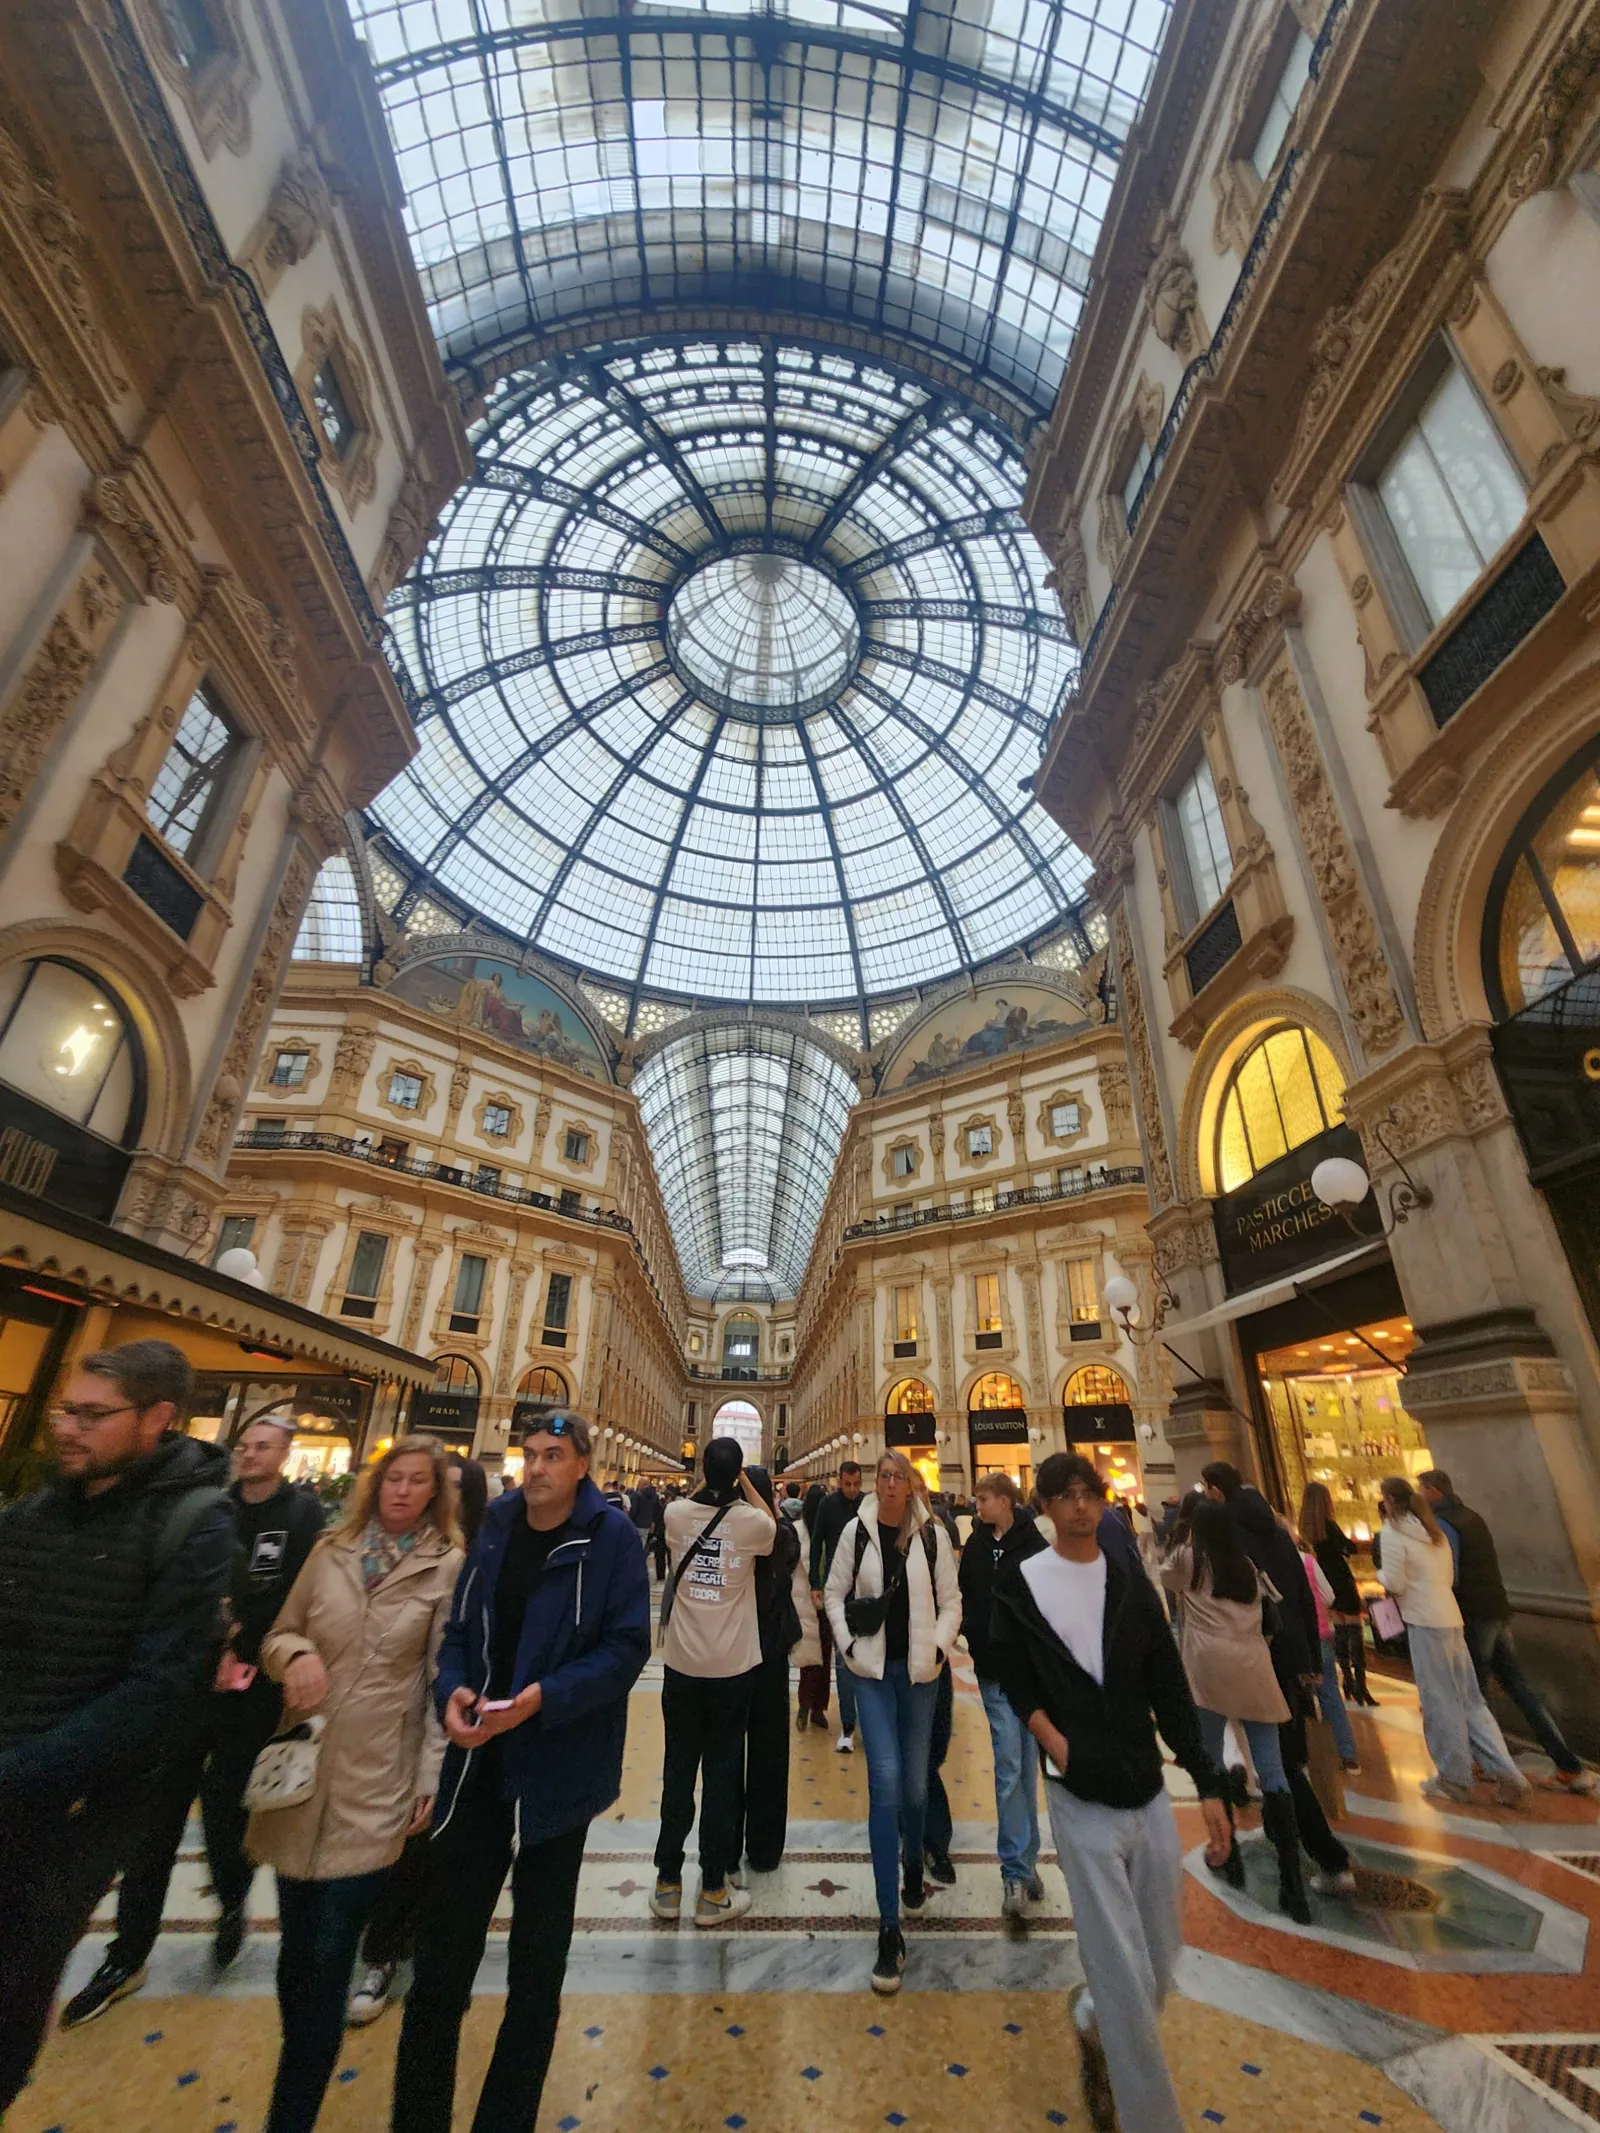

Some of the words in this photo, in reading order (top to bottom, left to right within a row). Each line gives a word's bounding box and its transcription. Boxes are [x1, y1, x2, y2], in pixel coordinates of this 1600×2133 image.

[1236, 1179, 1314, 1236] PASTICCE
[429, 1406, 461, 1416] PRADA
[974, 1422, 994, 1431] LOUIS
[995, 1421, 1025, 1430] VUITTON
